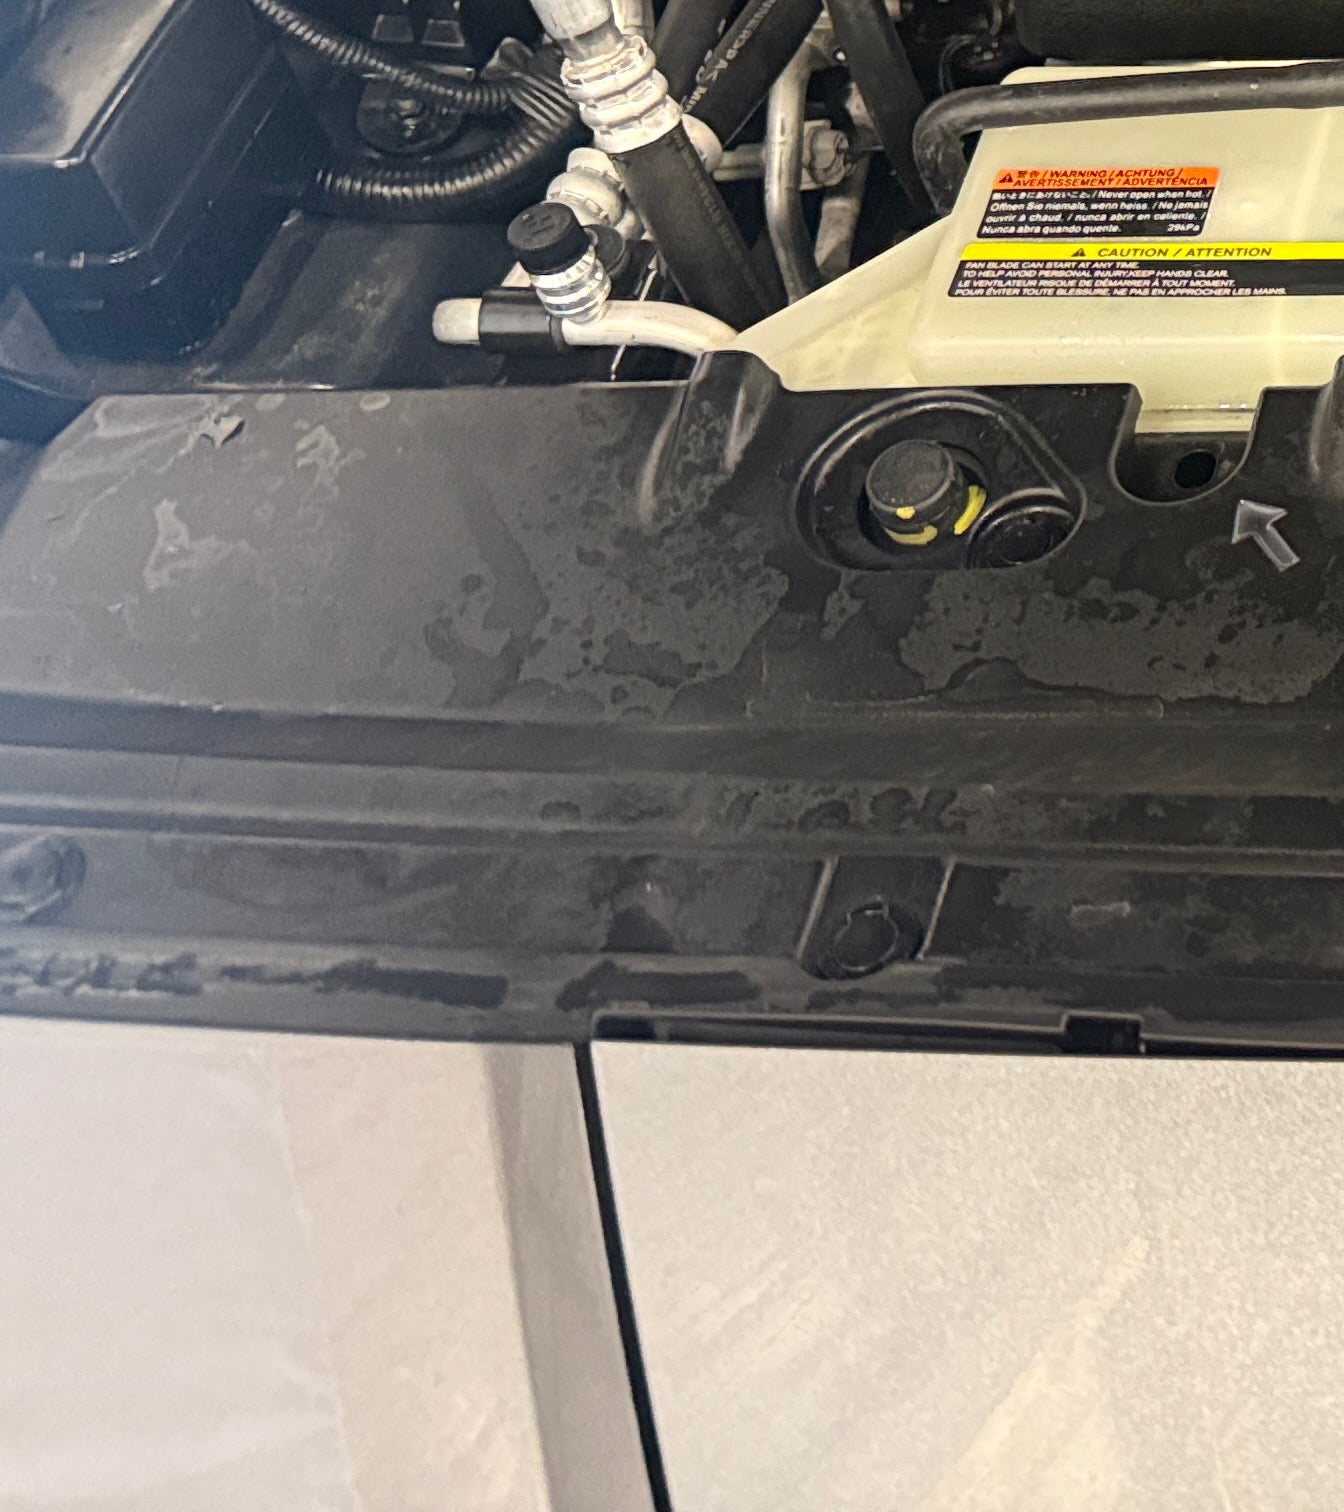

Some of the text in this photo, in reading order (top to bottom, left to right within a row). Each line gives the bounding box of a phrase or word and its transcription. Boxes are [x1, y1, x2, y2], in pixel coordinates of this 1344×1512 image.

[1049, 169, 1107, 178] WARNING
[1116, 169, 1175, 178] ACHTUNG
[1013, 178, 1114, 187] AVERTISSEMENT
[1098, 190, 1130, 199] Never
[1129, 191, 1156, 200] open
[1157, 190, 1184, 199] when
[985, 214, 1018, 223] ouvrir
[1074, 213, 1107, 222] nunca
[1109, 213, 1136, 222] abrir
[1136, 213, 1151, 222] en
[981, 225, 1016, 235] Nunca
[1016, 225, 1041, 234] abra
[1041, 225, 1082, 235] quando
[1097, 247, 1170, 257] CAUTION
[1185, 247, 1273, 257] ATTENTION
[965, 261, 987, 269] FAN
[986, 261, 1021, 269] BLADE
[1021, 261, 1045, 269] CAN
[1044, 261, 1079, 269] START
[1077, 261, 1093, 269] AT
[1091, 261, 1115, 269] ANY
[957, 279, 971, 288] LE
[972, 279, 1038, 288] VENTILATEUR
[1038, 279, 1078, 288] RISQUE
[1078, 279, 1094, 288] DE
[1094, 277, 1151, 287] DÉMARRER
[1161, 279, 1189, 288] TOUT
[954, 288, 985, 296] POUR
[985, 286, 1021, 296] ÉVITER
[1021, 288, 1055, 296] TOUTE
[1112, 288, 1129, 296] NE
[1128, 288, 1150, 296] PAS
[1150, 288, 1167, 296] EN
[1166, 288, 1232, 296] APPROCHER
[1231, 288, 1252, 296] LES
